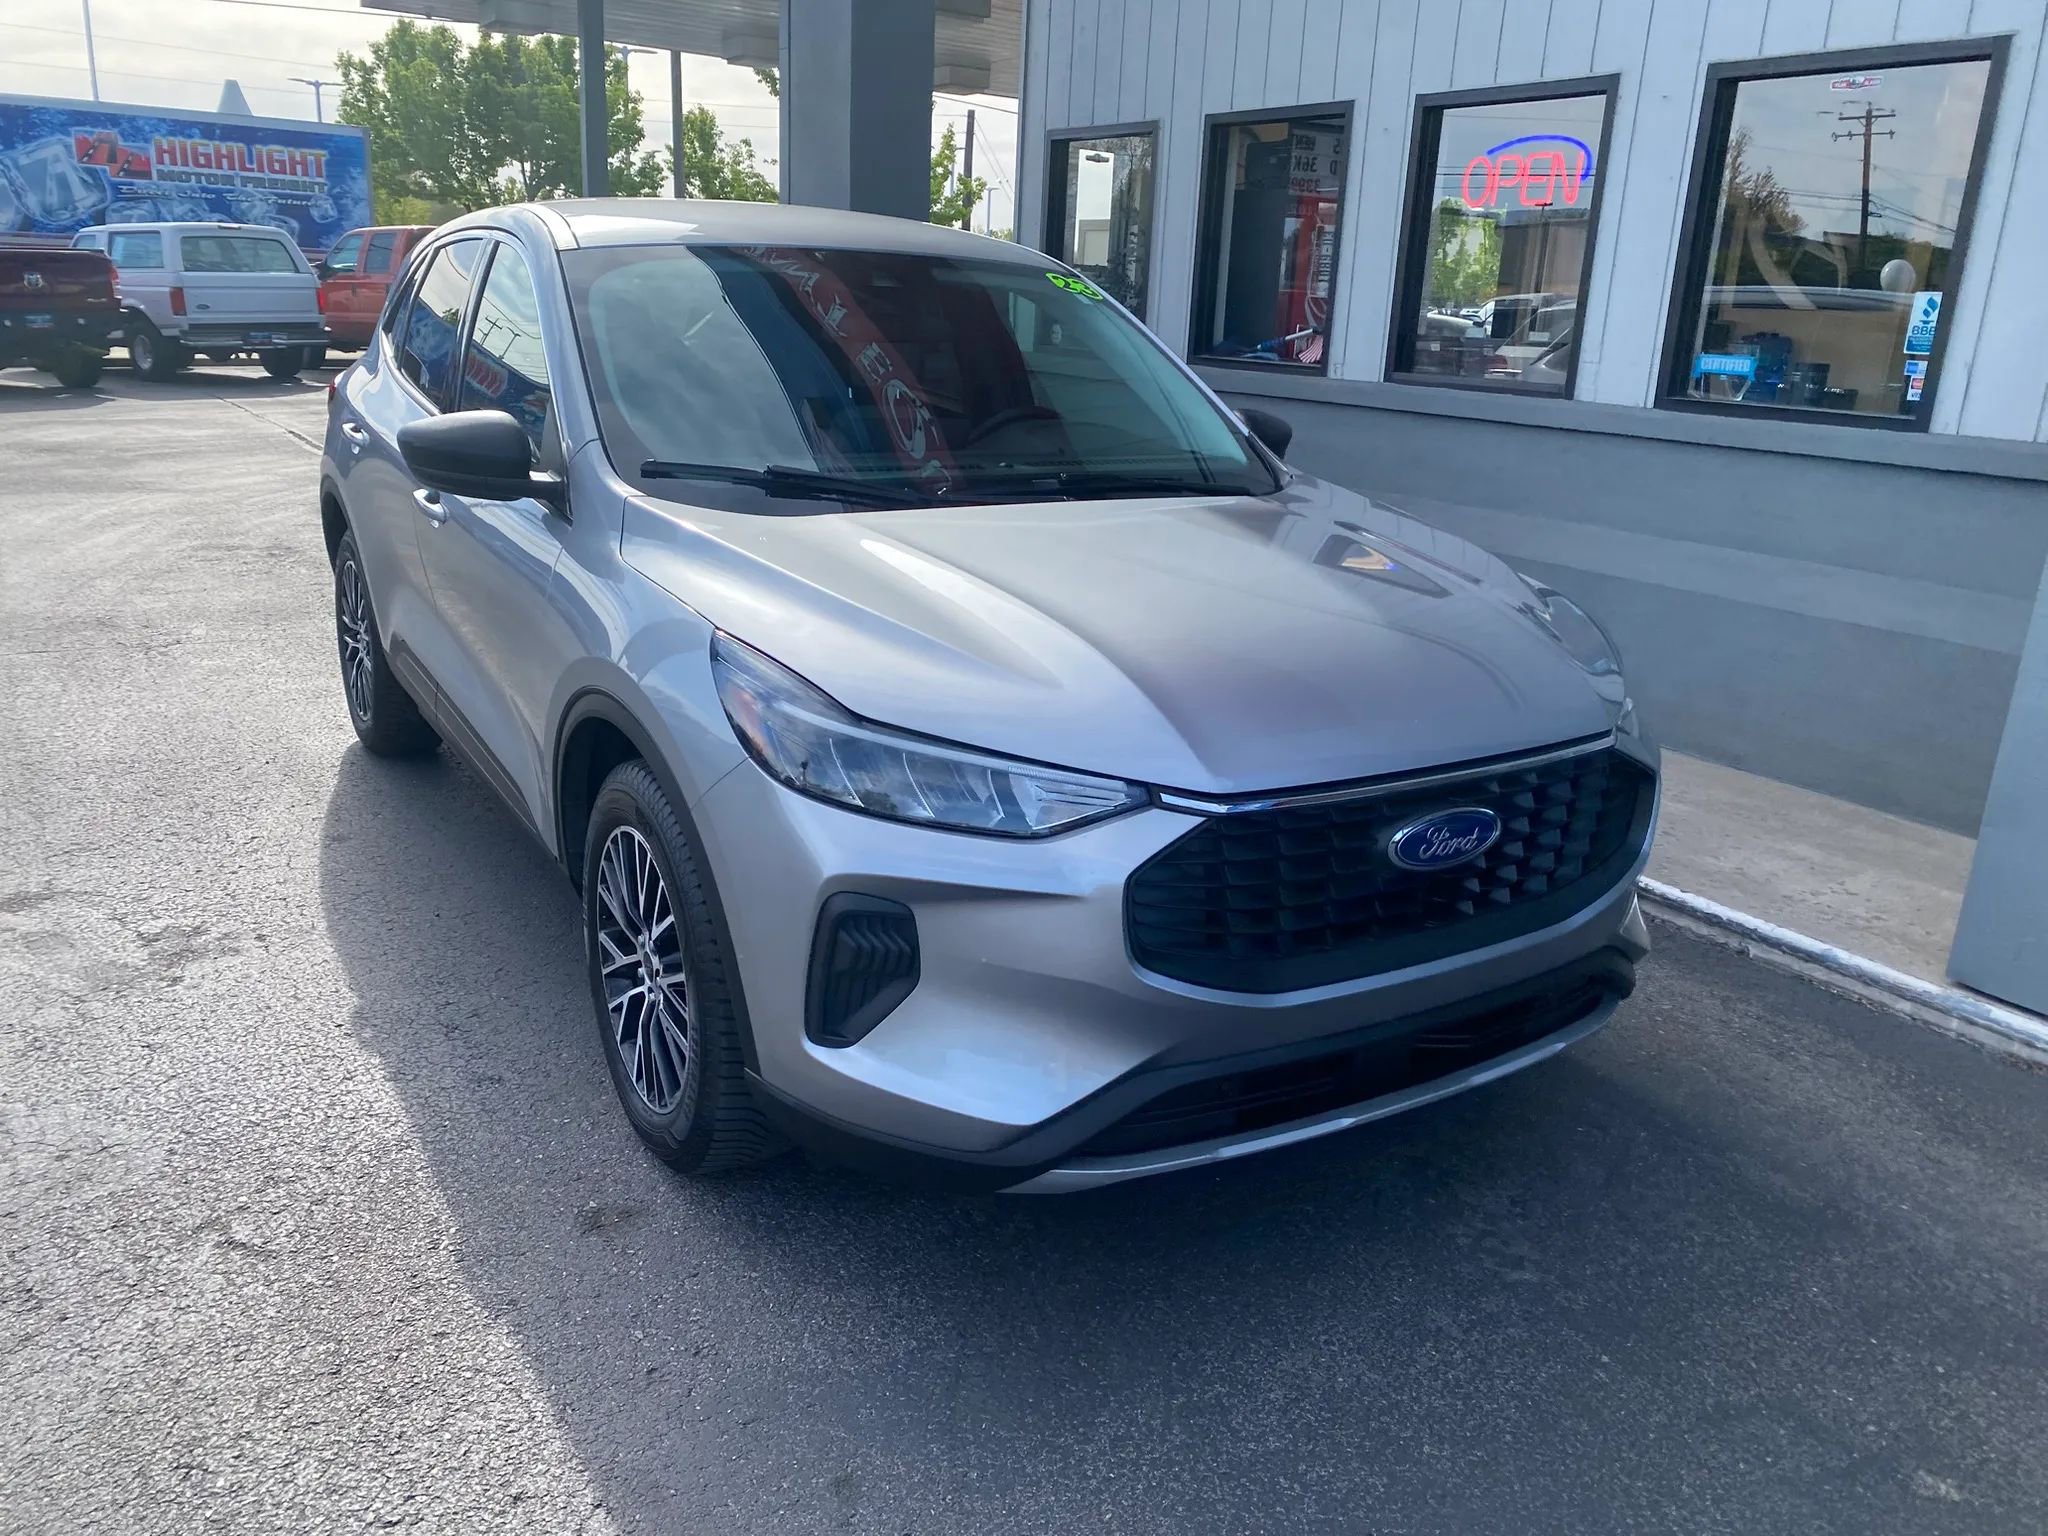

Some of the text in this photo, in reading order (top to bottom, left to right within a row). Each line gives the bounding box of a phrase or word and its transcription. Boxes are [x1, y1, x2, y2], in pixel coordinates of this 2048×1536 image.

[154, 137, 326, 178] HIGHLIGHT
[156, 168, 328, 194] MOTOR FREIGHT
[1462, 152, 1585, 208] OPEN
[1418, 826, 1480, 860] Ford
